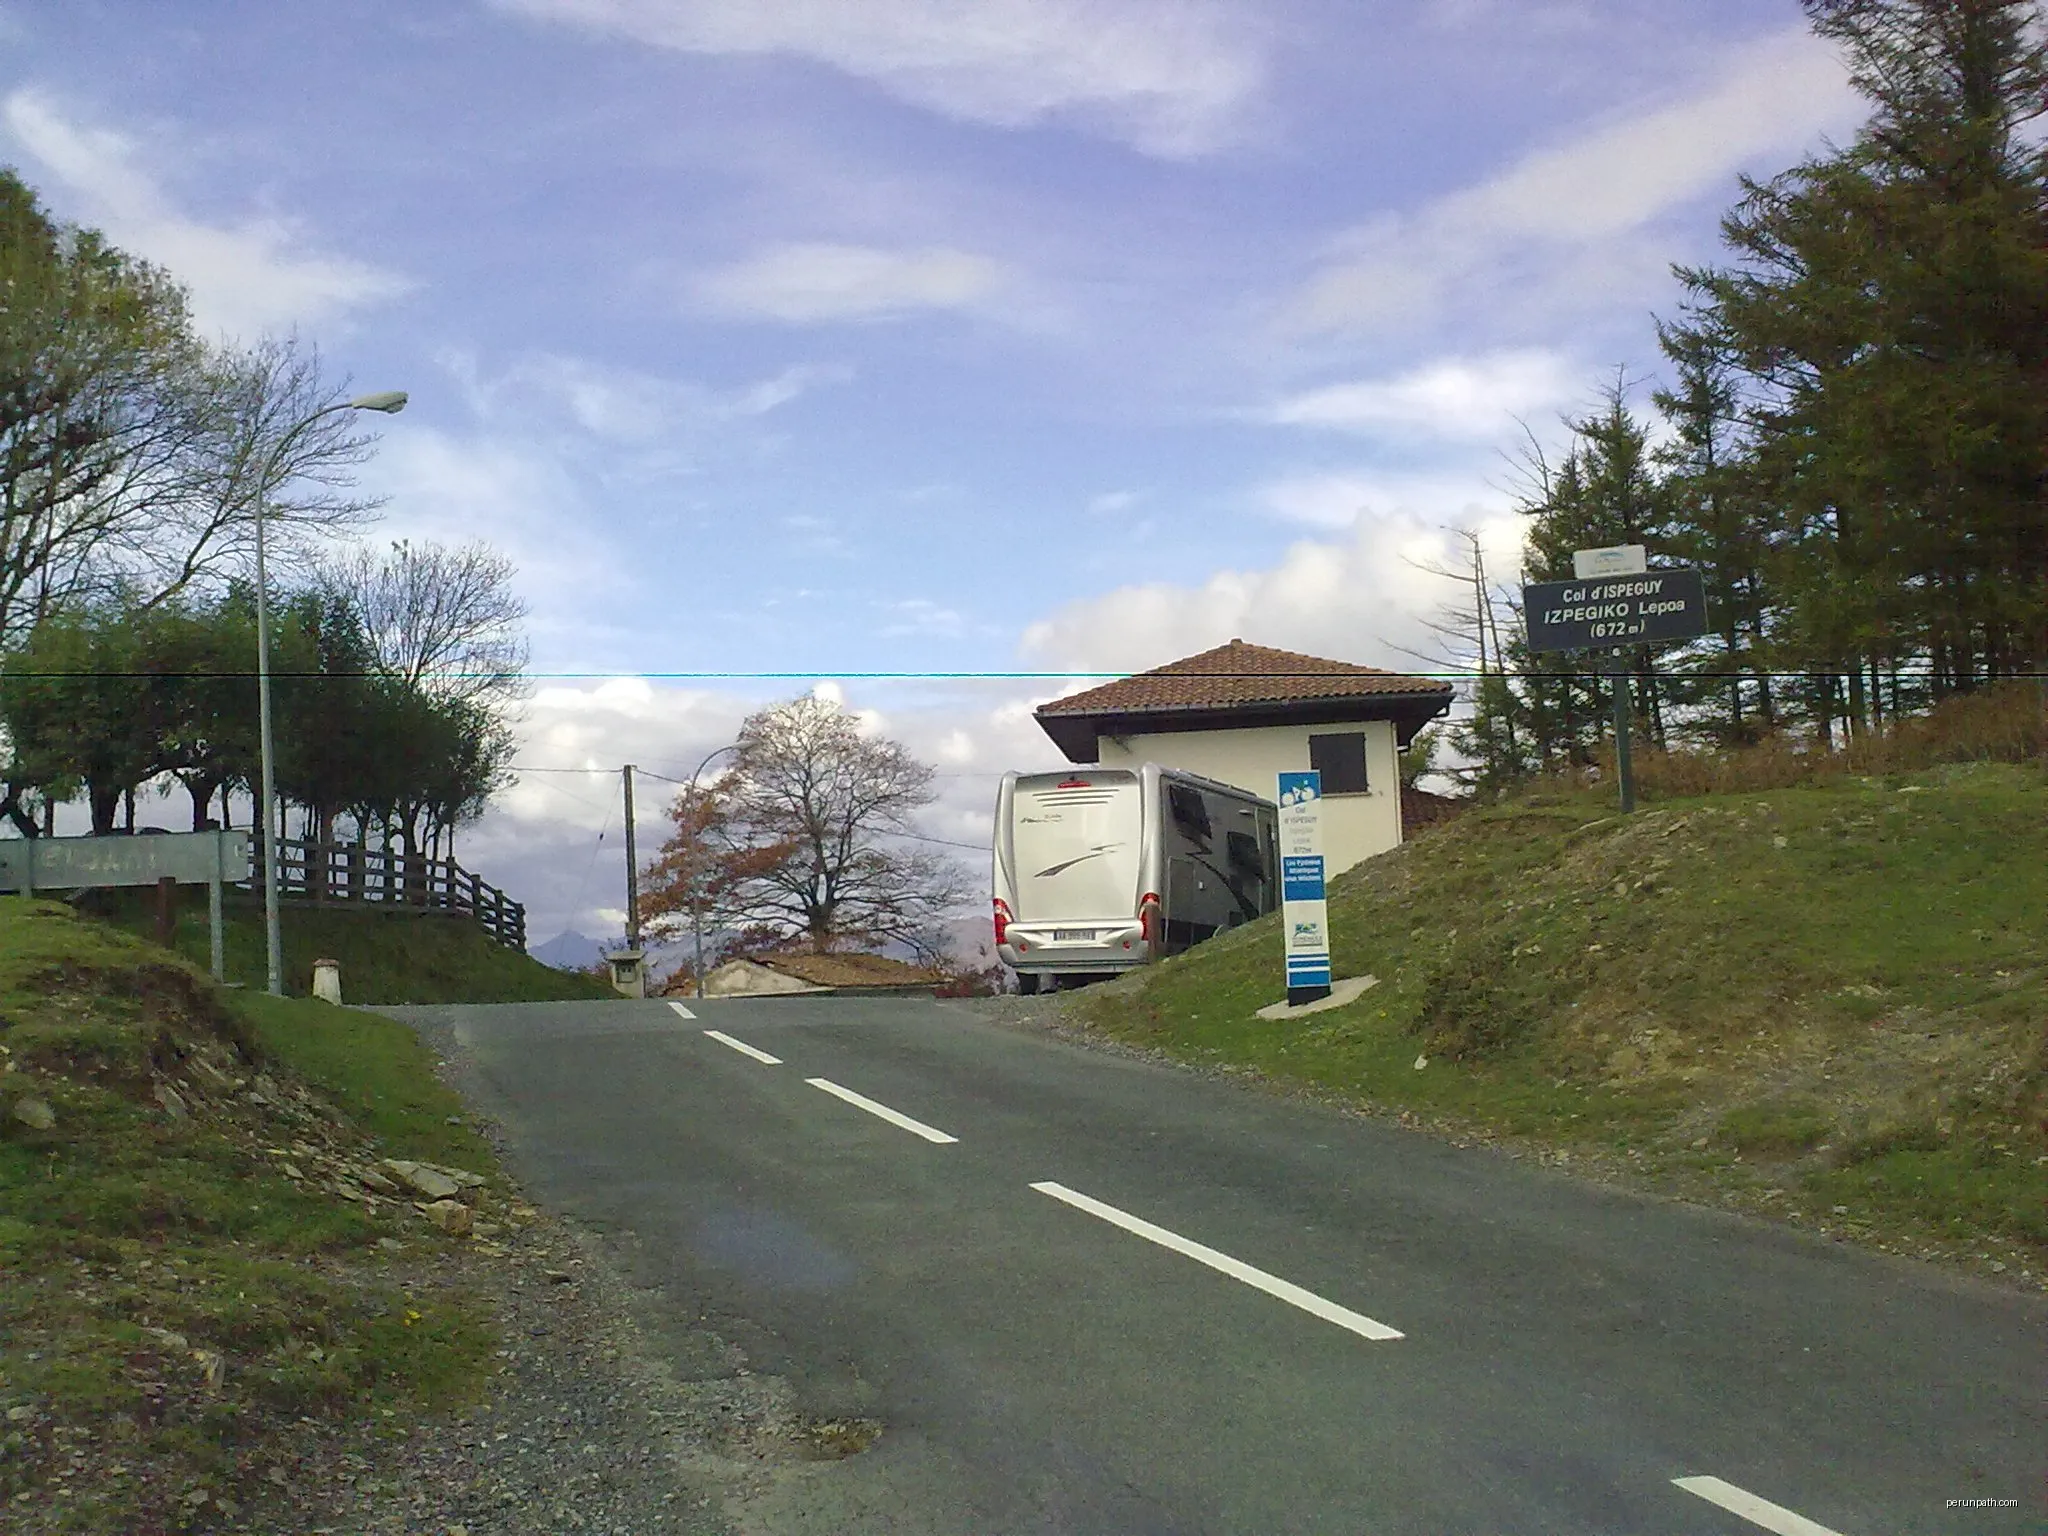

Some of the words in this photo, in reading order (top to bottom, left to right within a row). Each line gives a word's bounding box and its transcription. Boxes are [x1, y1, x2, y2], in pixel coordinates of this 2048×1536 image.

[1563, 588, 1586, 603] Col
[1591, 579, 1663, 600] d'ISPEGUY
[1544, 602, 1629, 625] IZPEGIKO
[1638, 599, 1686, 617] Lepoa
